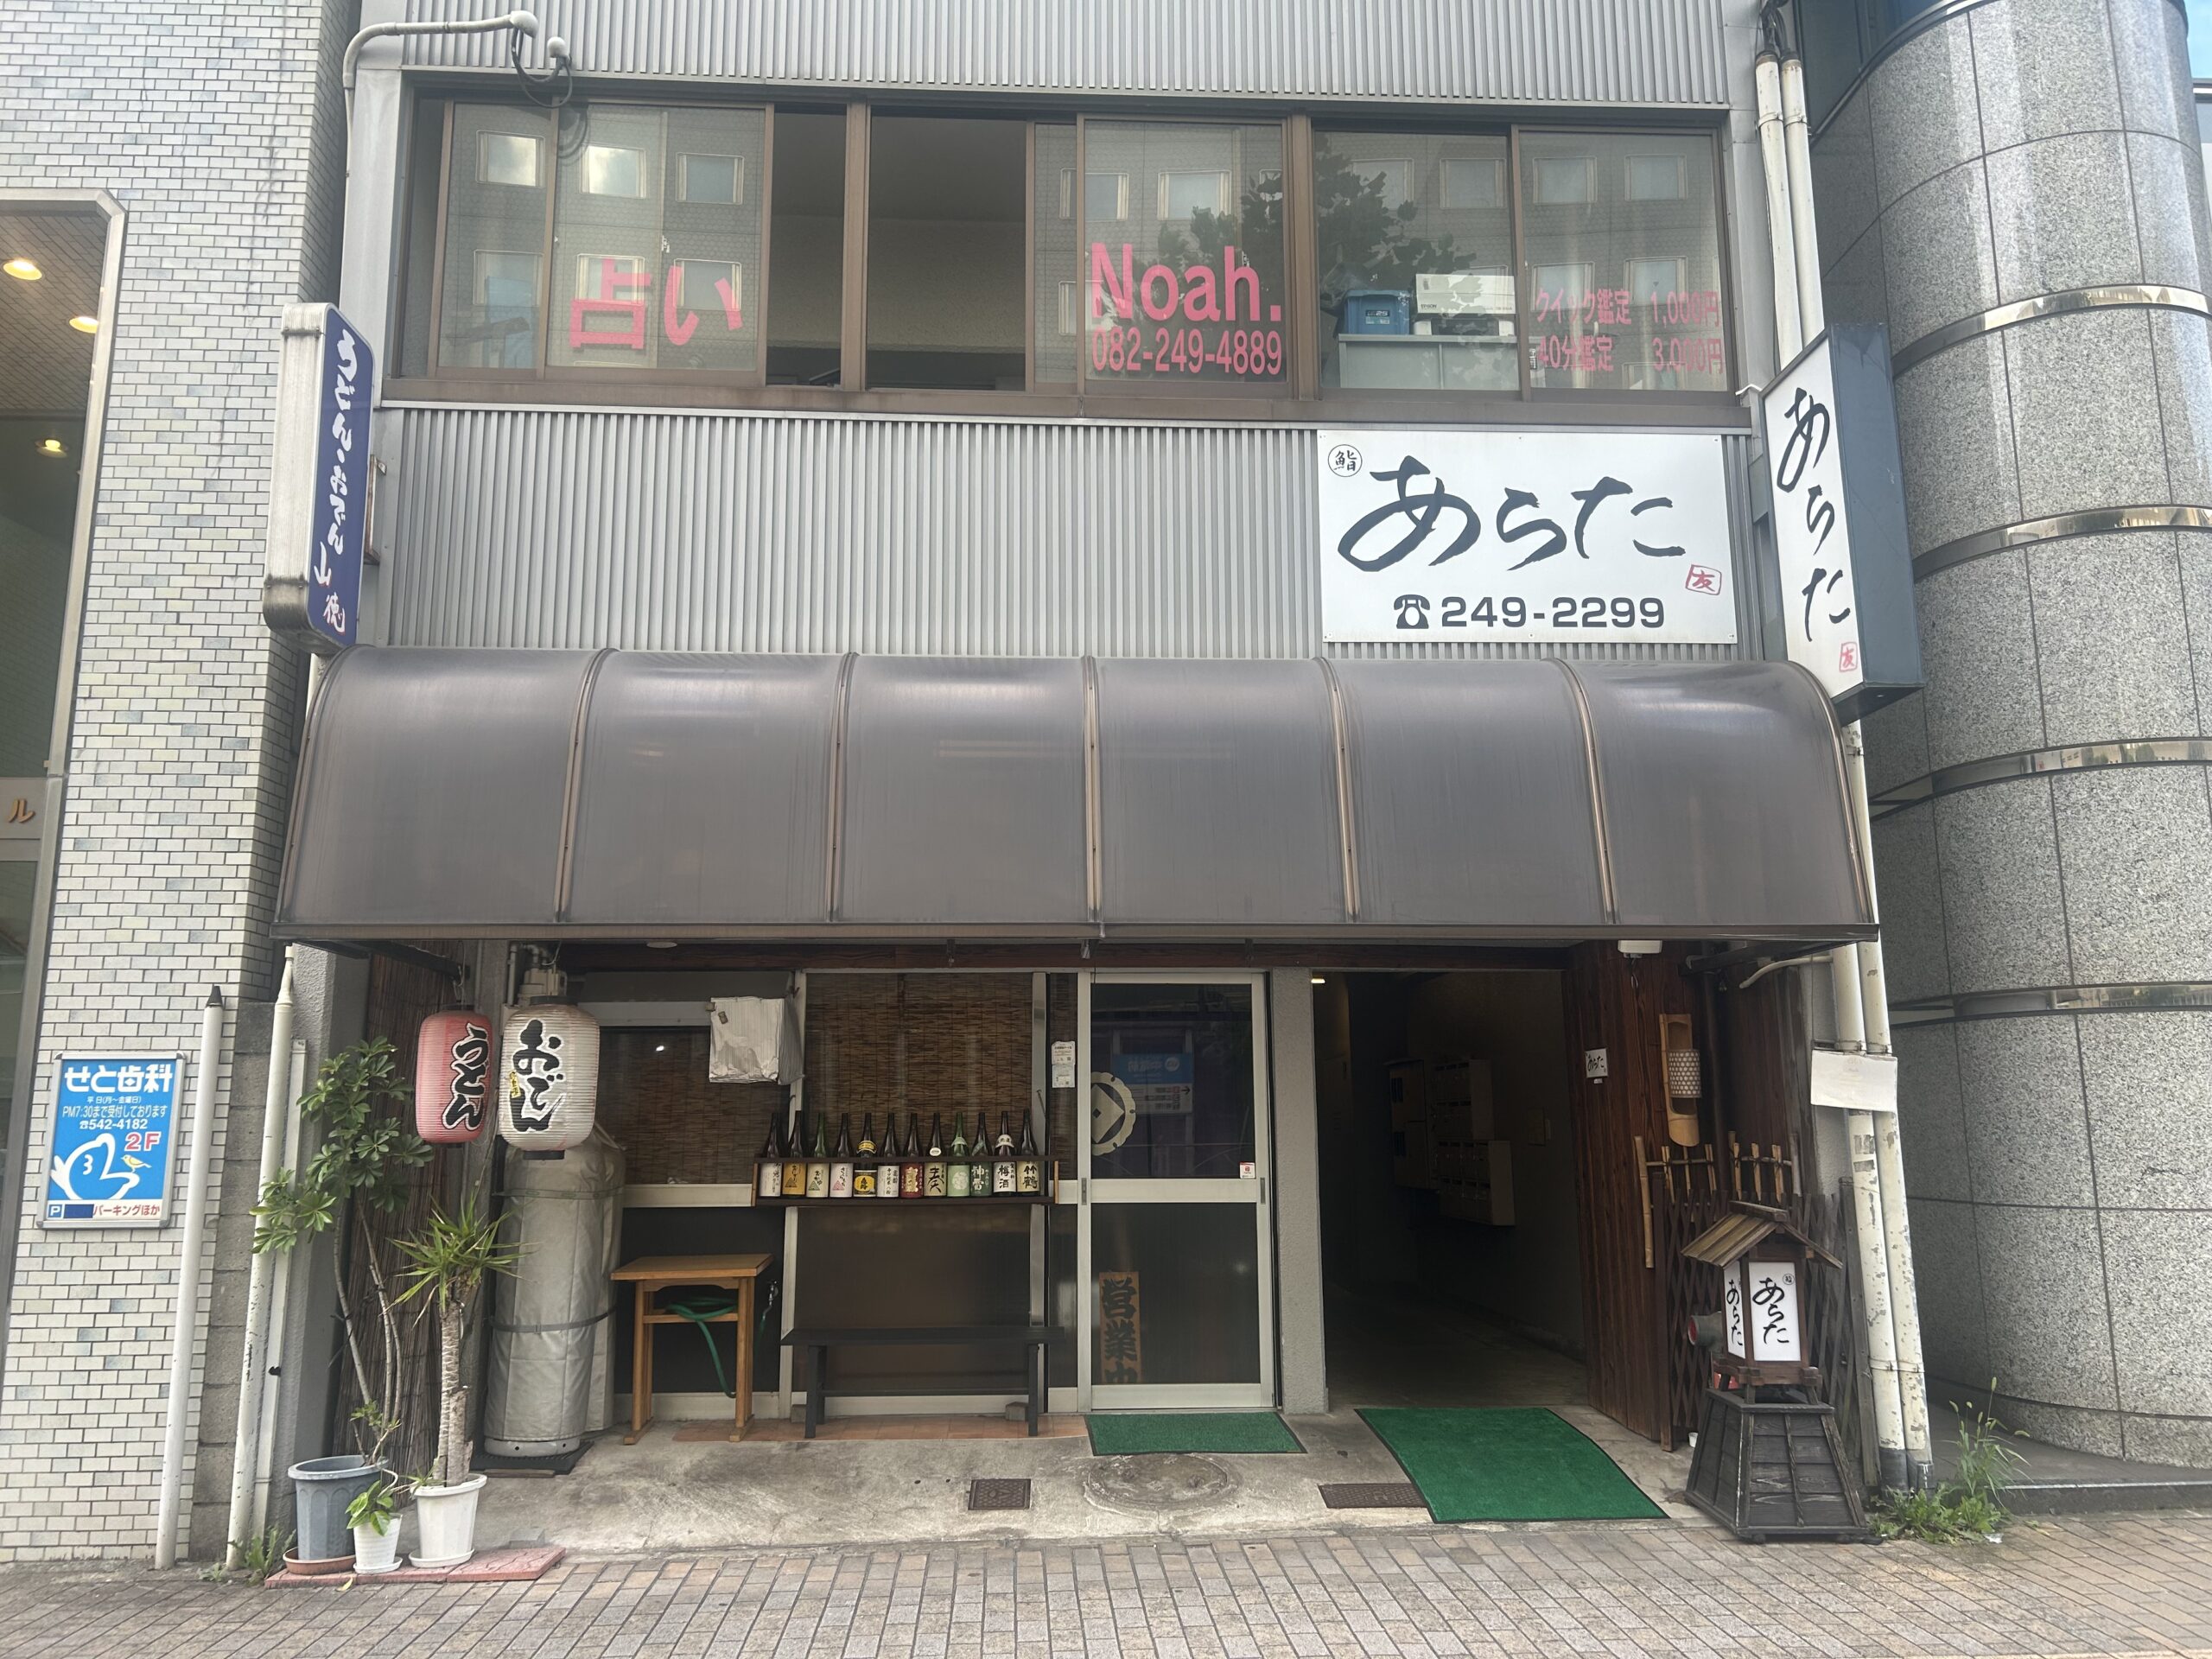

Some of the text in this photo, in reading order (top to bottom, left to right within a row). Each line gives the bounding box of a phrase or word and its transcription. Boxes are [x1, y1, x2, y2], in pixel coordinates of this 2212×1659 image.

[569, 257, 744, 350] 占い
[1091, 242, 1281, 321] Noah.
[1535, 289, 1720, 327] クイック鑑定 1,000円
[1091, 327, 1282, 375] 082-249-4889
[1537, 334, 1724, 374] 40分鑑定 3,000円
[1333, 449, 1357, 472] 鮨
[1337, 454, 1687, 573] あらた
[1777, 387, 1852, 642] あらた
[1441, 596, 1665, 628] 249-2299
[65, 1064, 173, 1093] せと歯科
[442, 1022, 489, 1131] うどん
[510, 1018, 566, 1133] おでん
[62, 1105, 168, 1118] PM7:30まで受付しております
[89, 1118, 149, 1130] 542-4182
[49, 1206, 60, 1217] P
[1726, 1279, 1743, 1345] あらた
[1752, 1277, 1789, 1344] あらた
